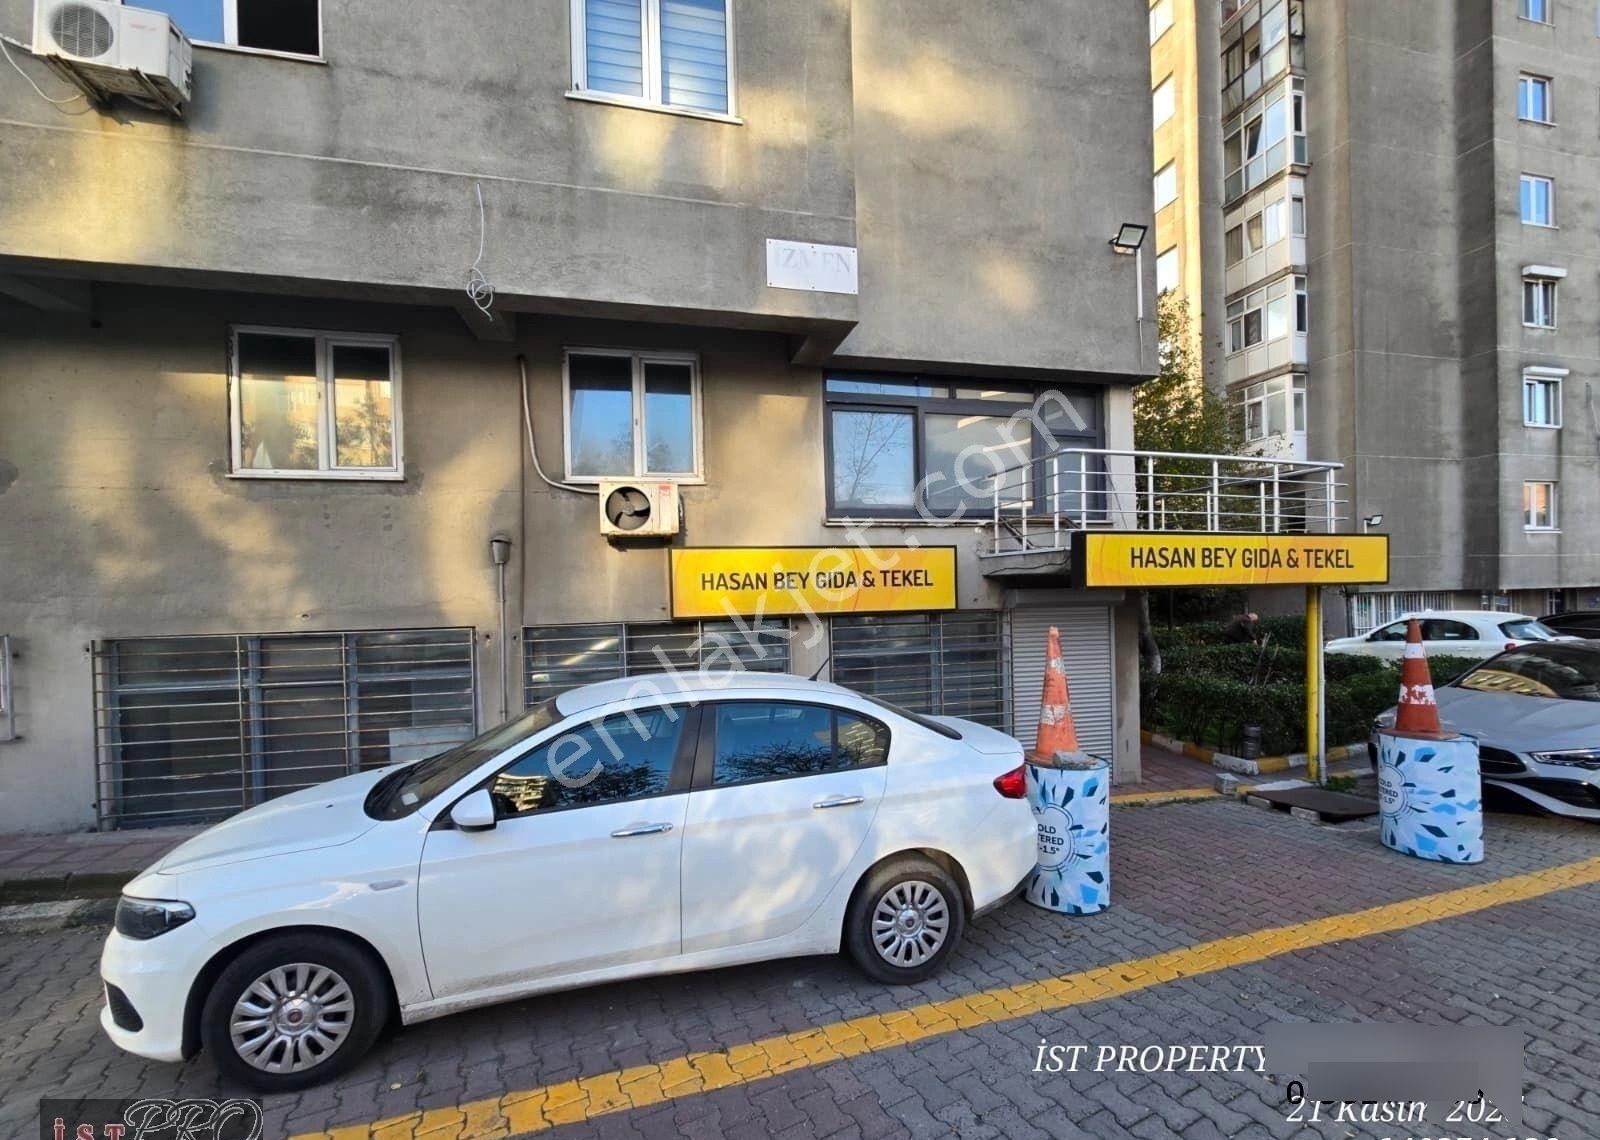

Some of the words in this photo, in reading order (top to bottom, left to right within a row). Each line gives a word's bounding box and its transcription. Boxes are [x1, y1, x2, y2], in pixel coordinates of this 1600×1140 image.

[1130, 547, 1196, 569] HASAN
[1201, 547, 1237, 569] BEY
[1241, 547, 1282, 569] GIDA
[1286, 548, 1299, 569] &
[1303, 548, 1354, 569] TEKEL
[701, 571, 768, 591] HASAN
[773, 571, 810, 590] BEY
[815, 570, 858, 590] GIDA
[862, 569, 876, 588] &
[880, 569, 934, 588] TEKEL
[1037, 823, 1057, 835] OLD
